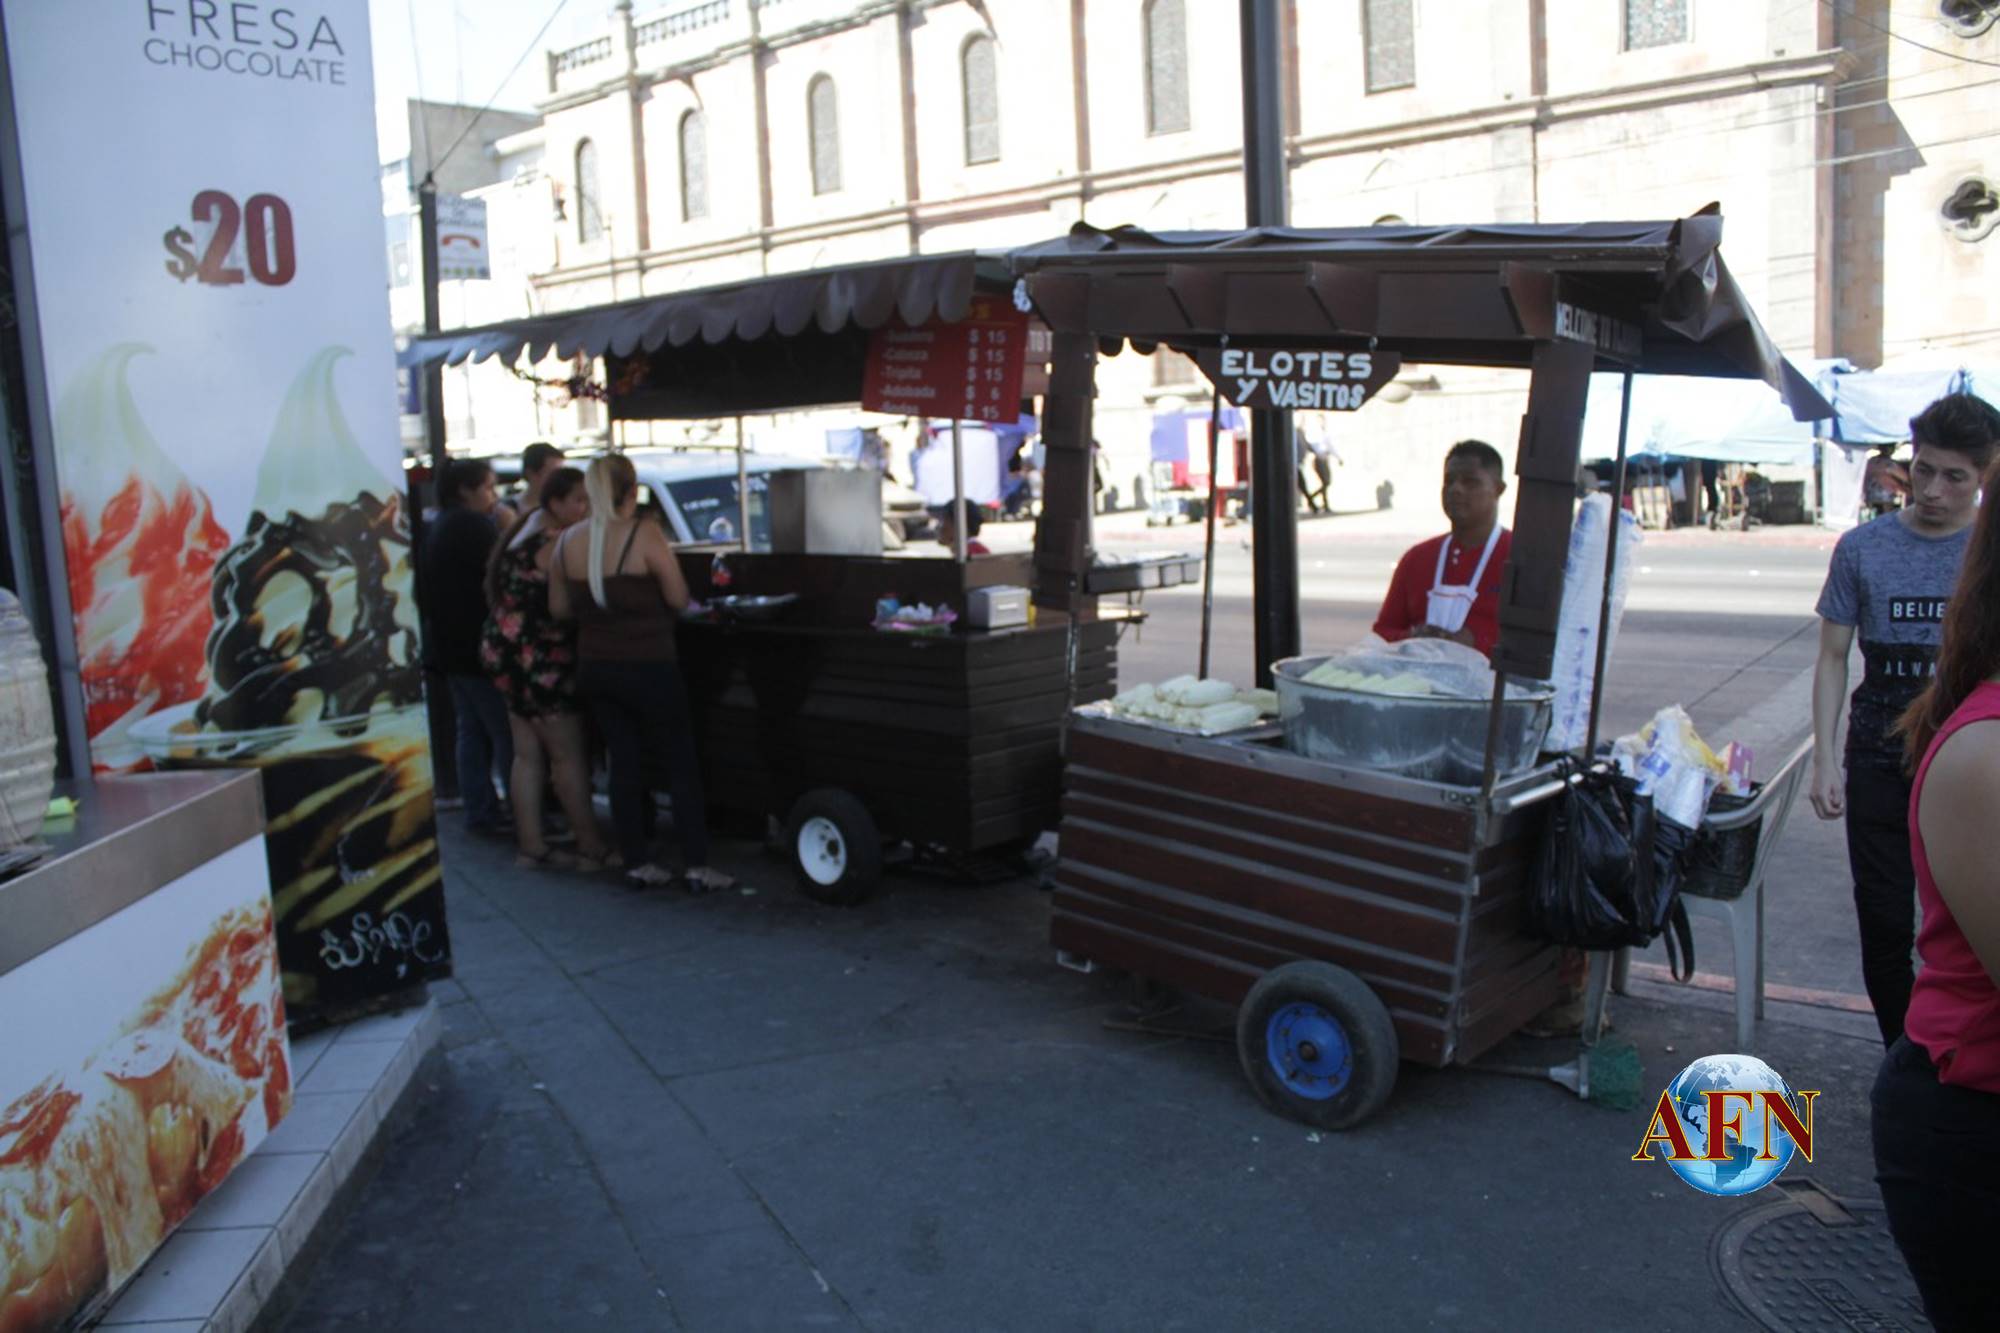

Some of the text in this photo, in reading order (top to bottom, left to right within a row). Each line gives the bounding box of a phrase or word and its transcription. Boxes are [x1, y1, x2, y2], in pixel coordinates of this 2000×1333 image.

[147, 0, 344, 56] FRESA
[144, 38, 347, 85] CHOCOLATE
[163, 189, 296, 287] $20
[987, 329, 1007, 345] 15
[985, 348, 1006, 363] 15
[1221, 349, 1373, 380] ELOTES
[984, 367, 1004, 382] 15
[1236, 378, 1366, 410] Y VASITOS
[982, 405, 1000, 420] 15
